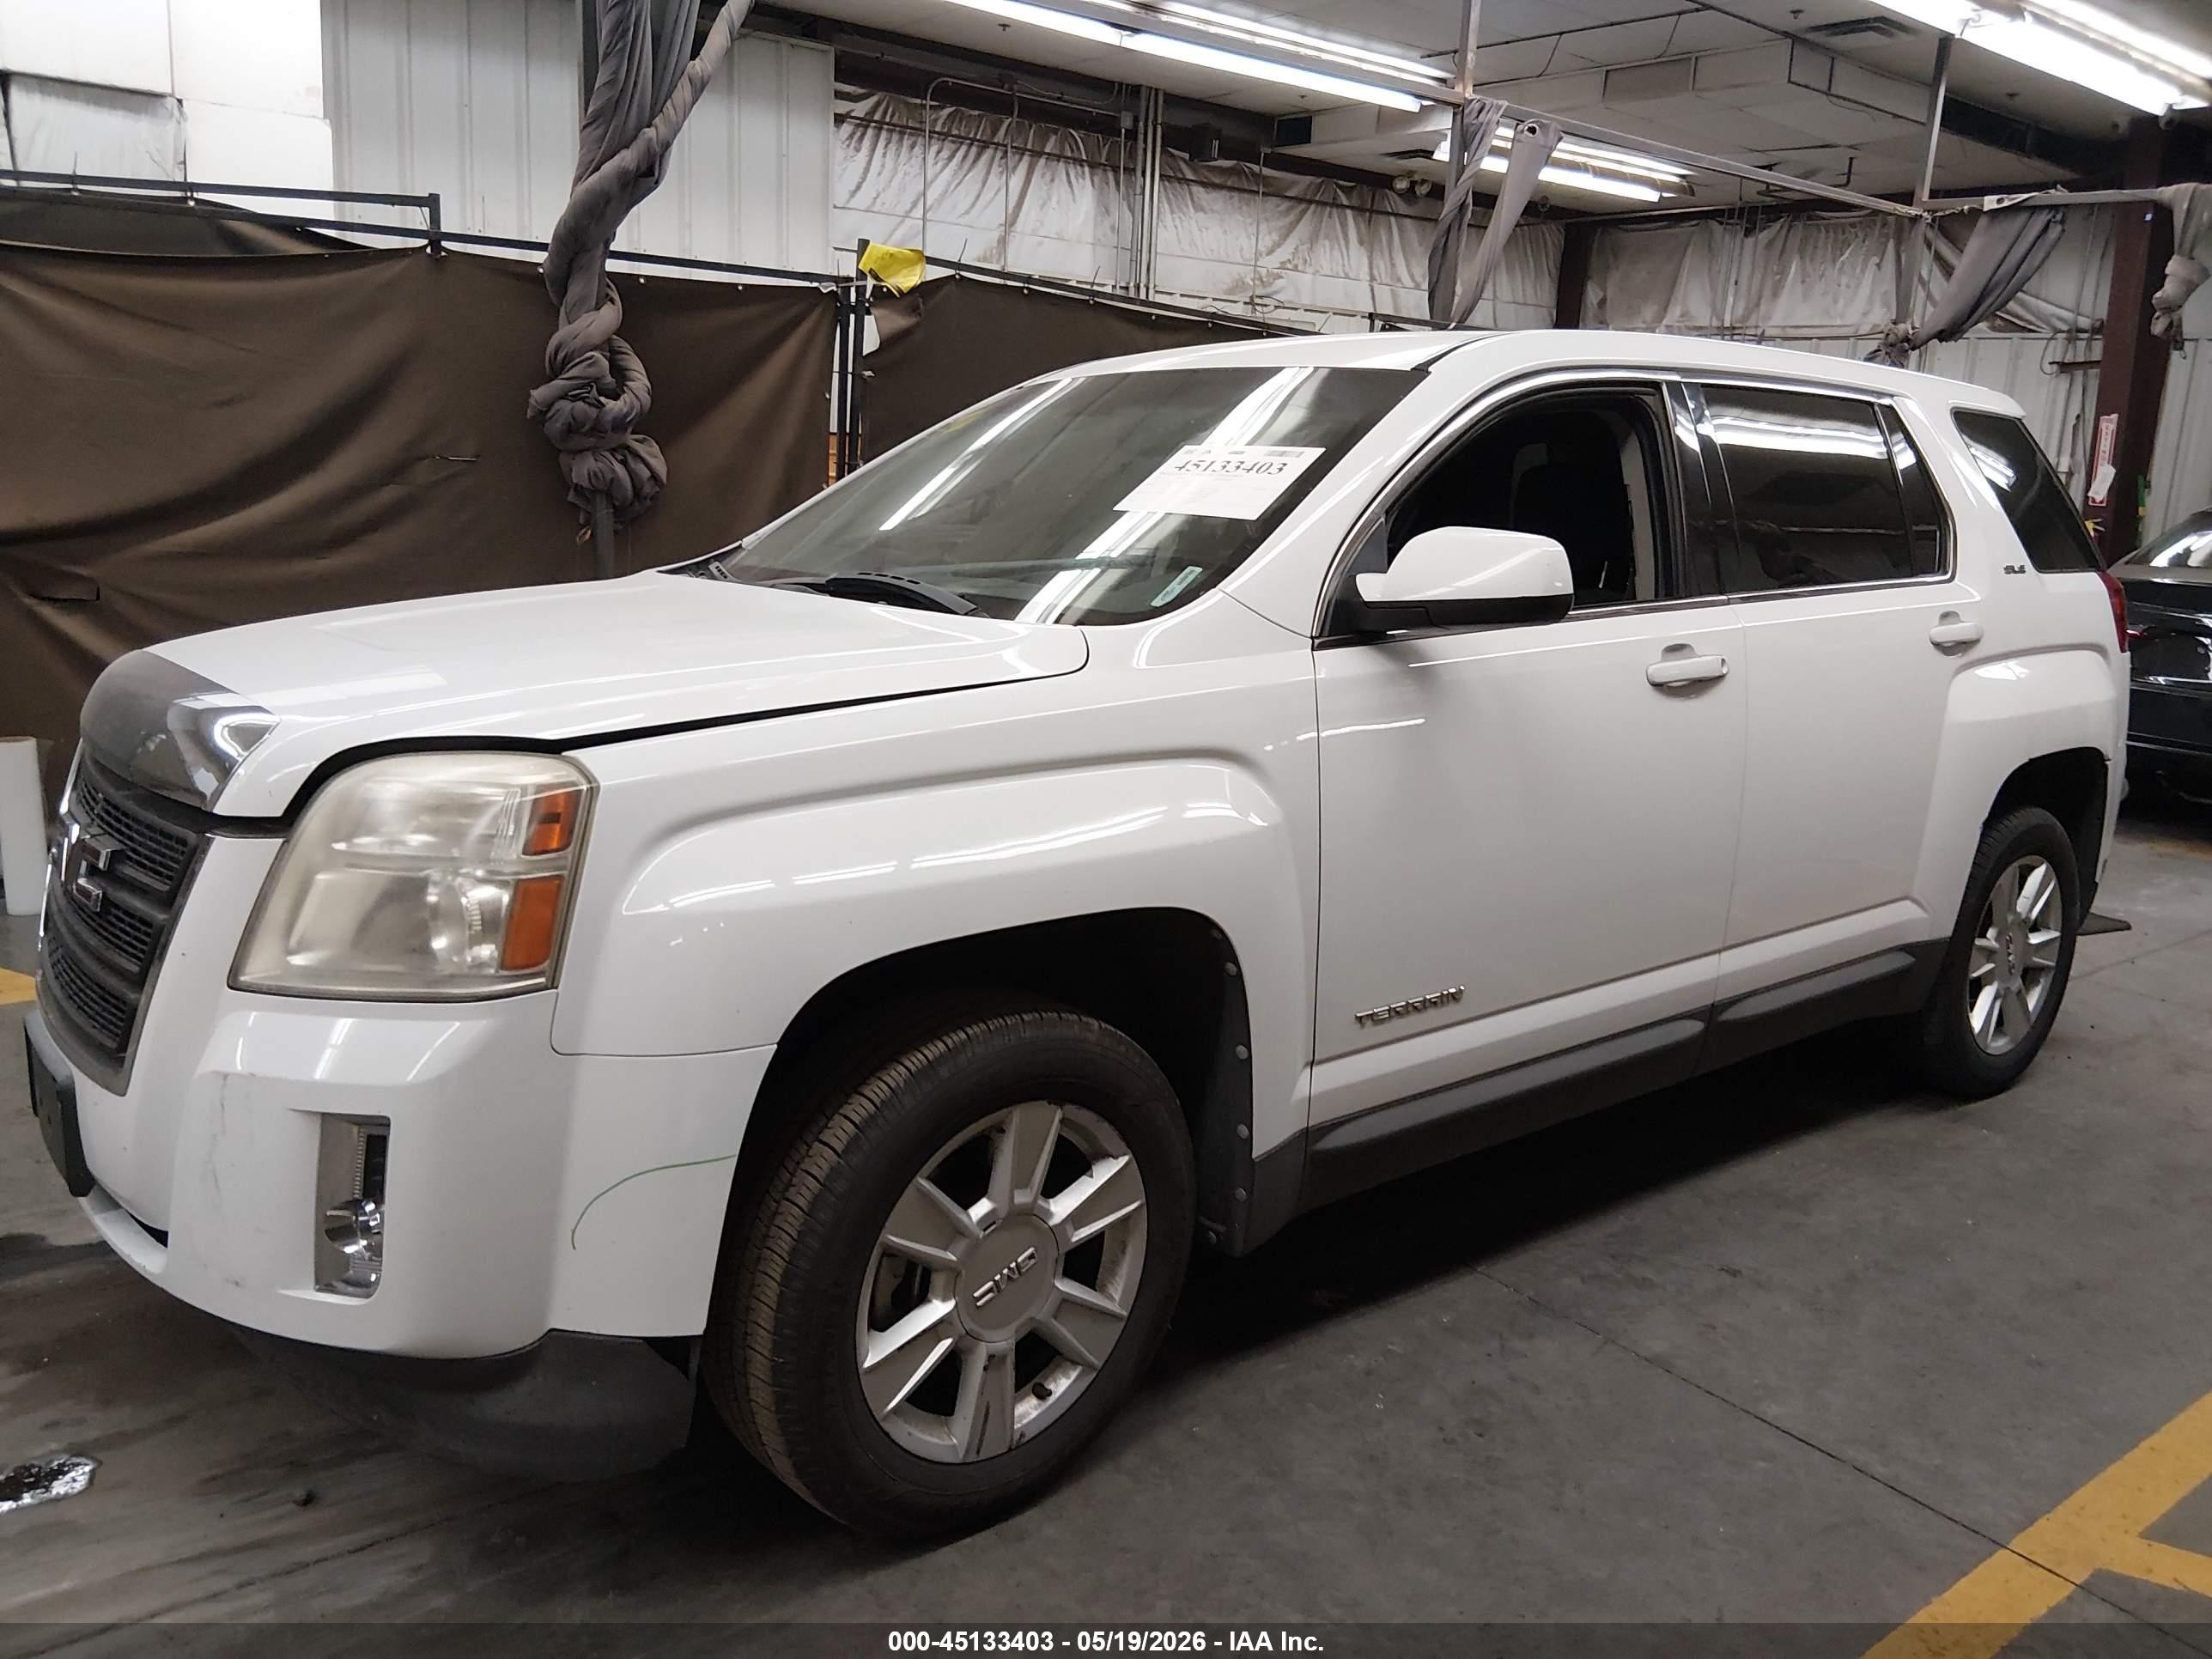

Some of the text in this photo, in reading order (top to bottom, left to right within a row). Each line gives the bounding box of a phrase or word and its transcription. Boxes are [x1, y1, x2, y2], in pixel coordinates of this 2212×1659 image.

[1174, 459, 1289, 475] 45133403
[1354, 985, 1465, 1027] TERRAIN
[973, 1247, 1038, 1307] GMC
